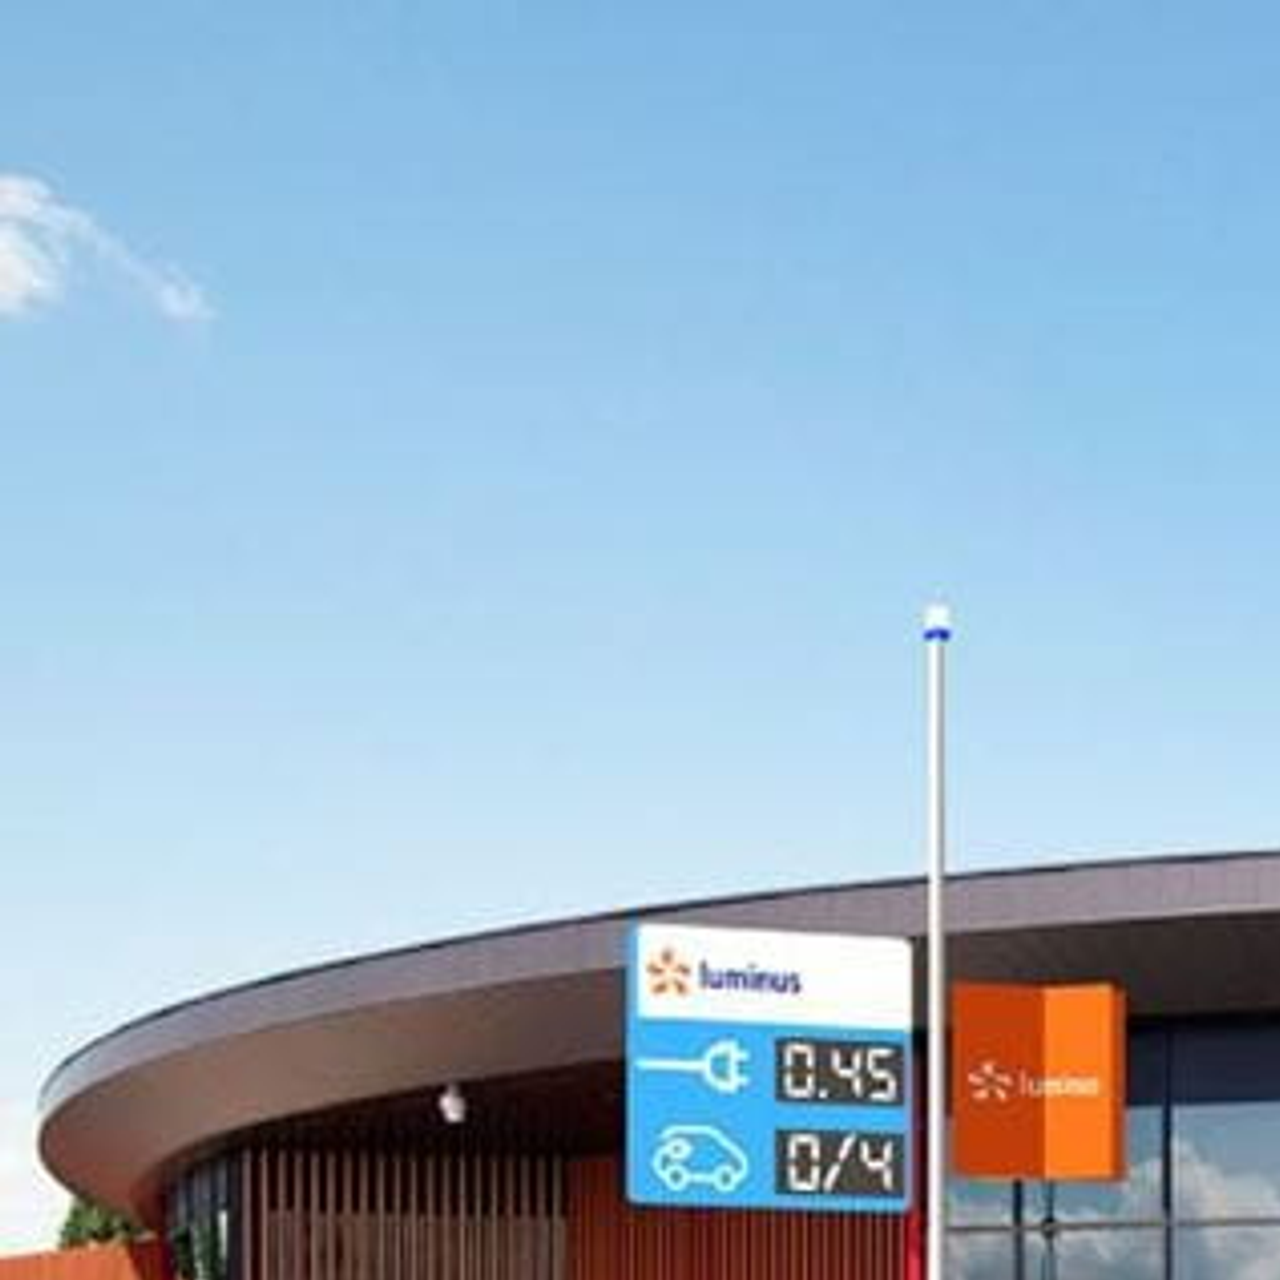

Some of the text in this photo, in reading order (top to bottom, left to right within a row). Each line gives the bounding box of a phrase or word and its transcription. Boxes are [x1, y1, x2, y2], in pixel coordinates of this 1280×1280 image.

[699, 961, 802, 994] luminus
[782, 1044, 897, 1101] 0.45
[787, 1133, 894, 1193] 0/4
